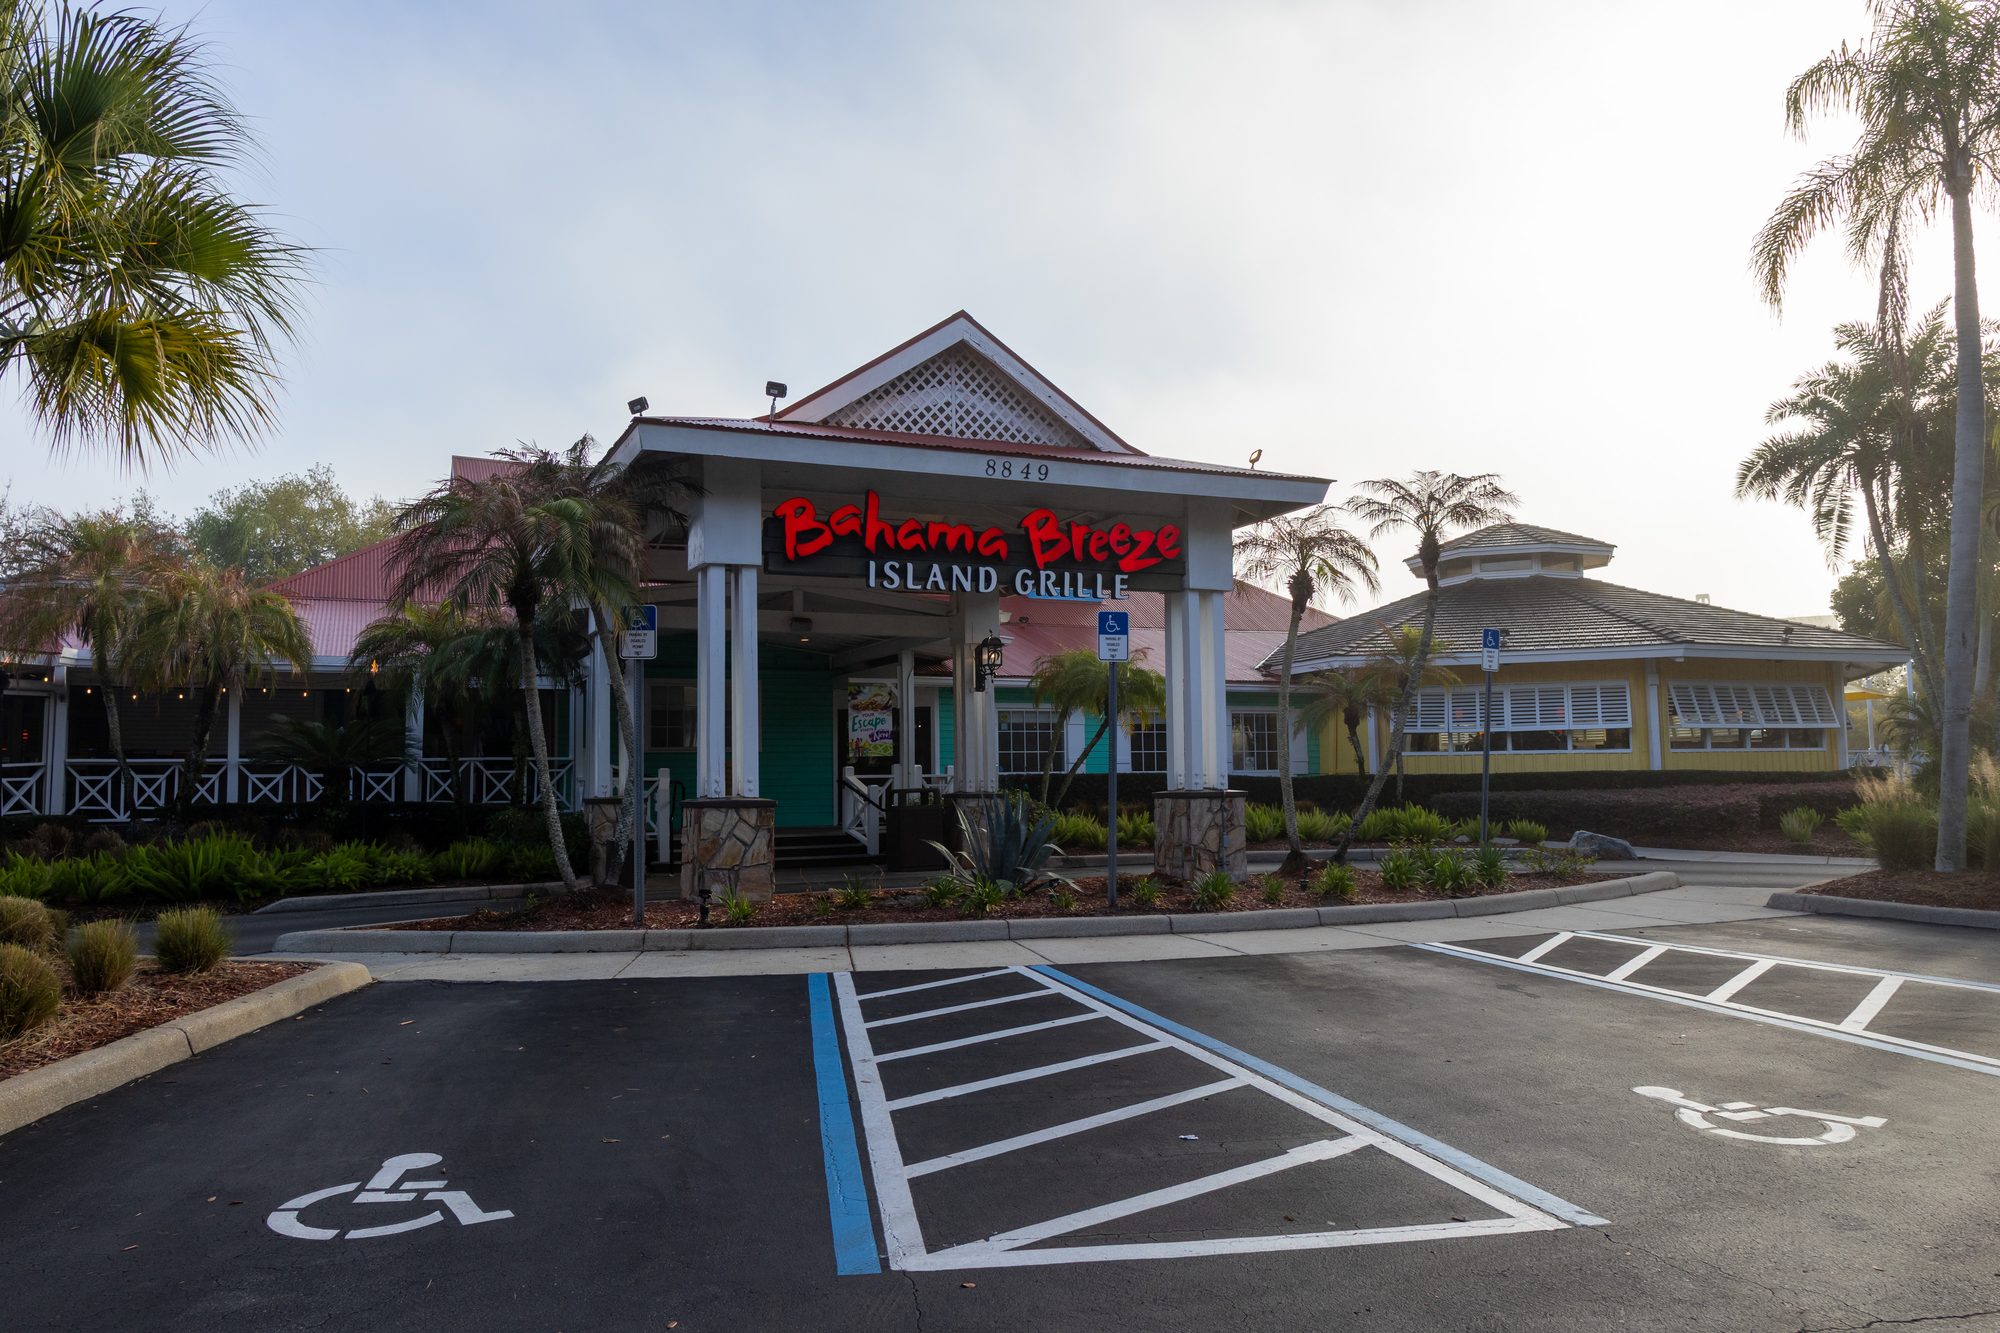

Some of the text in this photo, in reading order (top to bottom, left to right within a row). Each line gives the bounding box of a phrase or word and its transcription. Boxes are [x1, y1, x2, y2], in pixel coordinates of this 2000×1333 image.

[985, 459, 1049, 481] 8849
[773, 489, 1182, 573] Bahama Breeze
[867, 560, 1130, 599] ISLAND GRILLE
[852, 715, 886, 732] Escape
